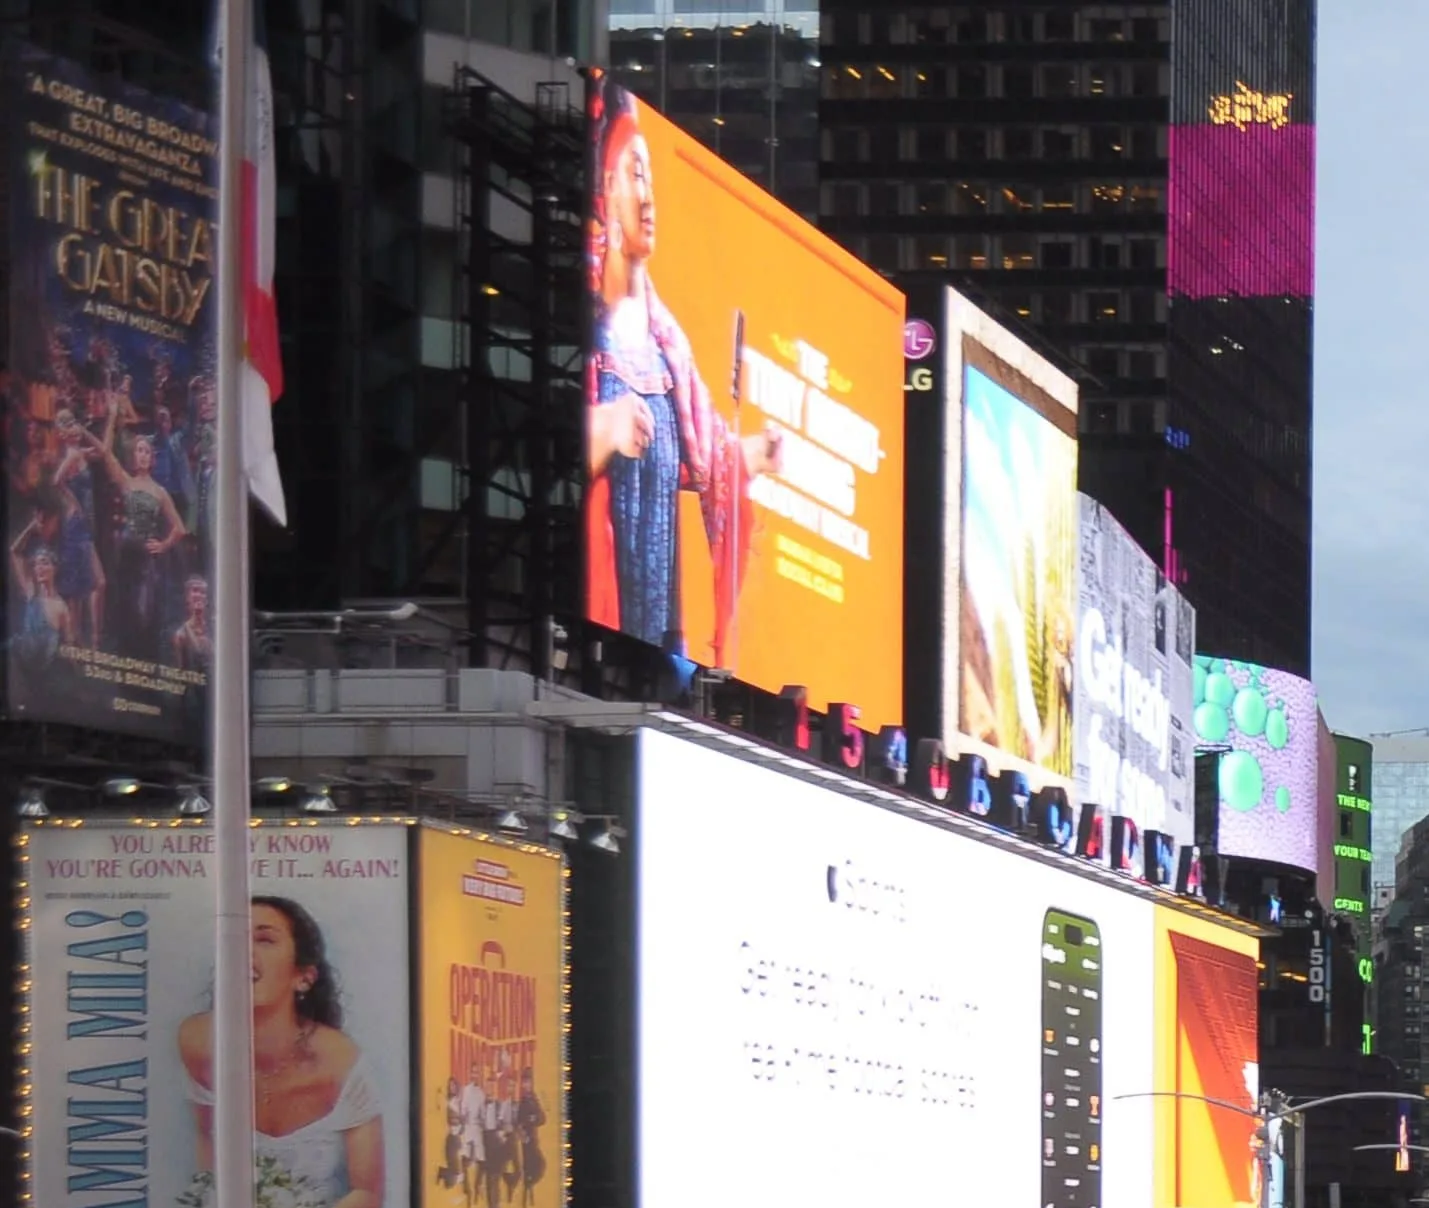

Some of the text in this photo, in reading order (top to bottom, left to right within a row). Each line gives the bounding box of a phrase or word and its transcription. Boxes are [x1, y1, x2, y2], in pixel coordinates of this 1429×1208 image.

[108, 189, 219, 267] GREA
[56, 232, 211, 325] GATSBY
[47, 858, 123, 880] YOU'RE
[129, 858, 208, 879] GONNA
[321, 858, 400, 880] AGAIN!
[110, 833, 334, 855] YOU ALREY KNOW
[65, 908, 150, 1041] MIA!
[450, 962, 537, 1042] OPERATION
